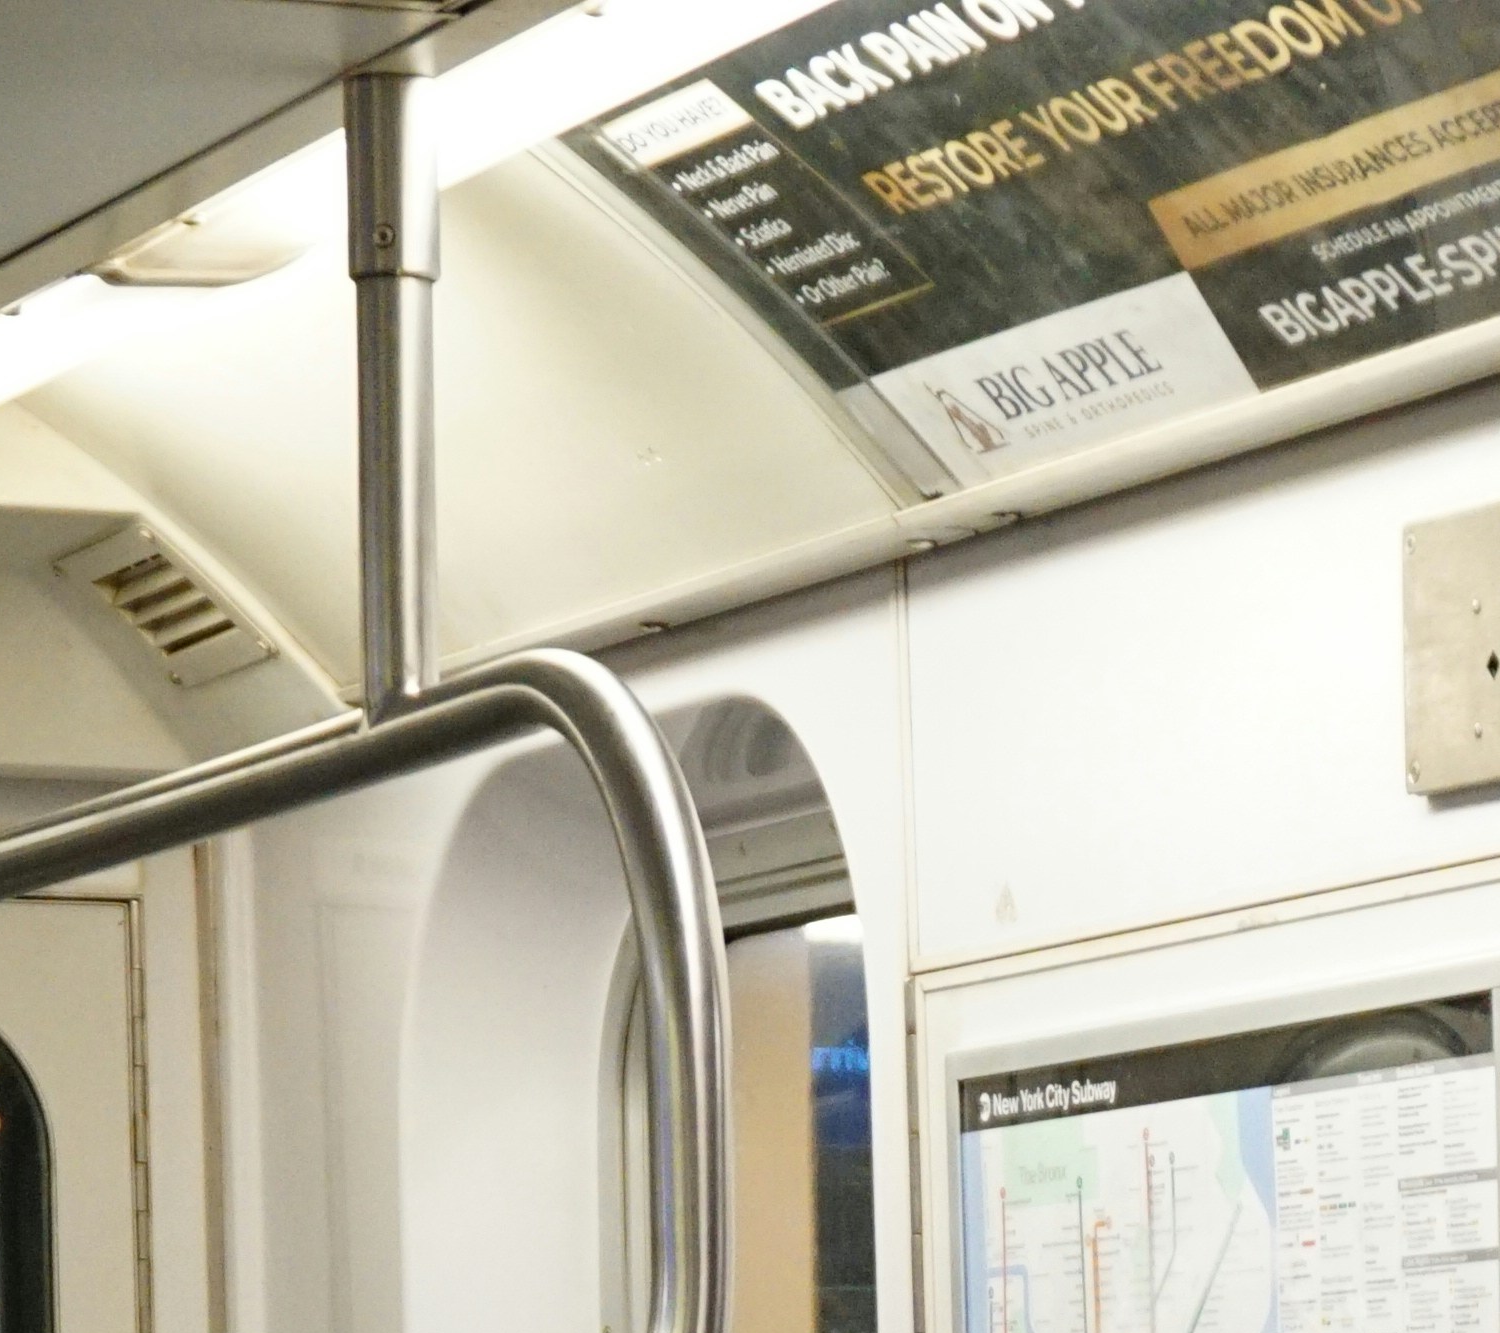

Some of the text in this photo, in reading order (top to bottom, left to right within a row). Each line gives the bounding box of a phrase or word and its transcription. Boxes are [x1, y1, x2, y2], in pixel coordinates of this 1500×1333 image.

[754, 43, 894, 129] BACK
[860, 2, 988, 81] PAIN
[616, 96, 729, 153] DO YOU HAVE?
[861, 0, 1366, 214] RESTORE YOUR FREEDOM
[675, 164, 716, 191] Neck
[743, 138, 781, 163] Pain
[1179, 209, 1230, 239] ALL
[1228, 176, 1296, 225] MAJOR
[1292, 131, 1433, 197] INSURANCES
[708, 182, 779, 219] Nerve Pain
[740, 217, 793, 247] Sciatica
[769, 231, 861, 275] Herniated Disc
[1311, 221, 1389, 262] SCHEDULE
[1382, 216, 1410, 239] AN
[802, 257, 892, 304] Or Other Pain?
[974, 328, 1164, 421] BIG APPLE
[1022, 418, 1067, 439] SPINE
[1080, 379, 1176, 421] ORTHOPEDICS
[992, 1077, 1118, 1117] New York City Subway
